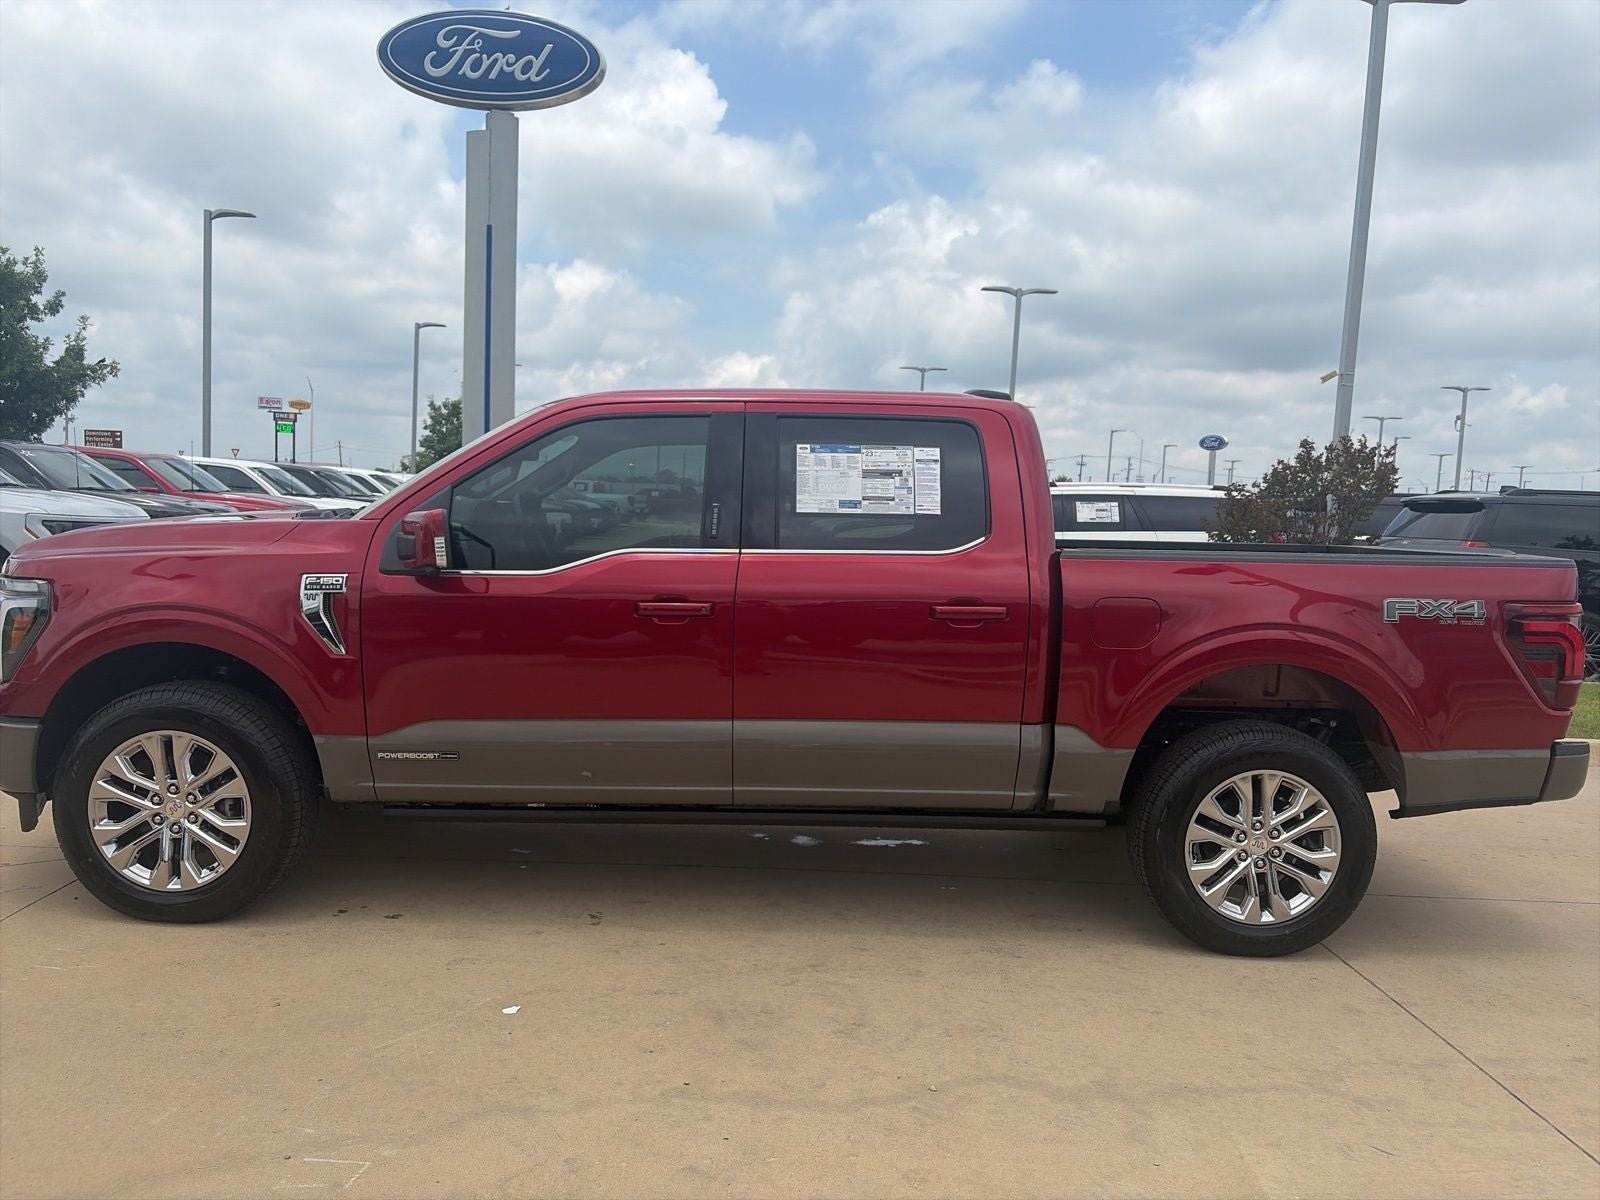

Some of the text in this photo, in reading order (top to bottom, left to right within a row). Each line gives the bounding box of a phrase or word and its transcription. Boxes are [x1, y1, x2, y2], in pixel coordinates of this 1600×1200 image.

[424, 25, 553, 82] Ford
[260, 397, 281, 406] Exxon
[1203, 437, 1220, 447] Ford
[1383, 598, 1486, 623] FX4
